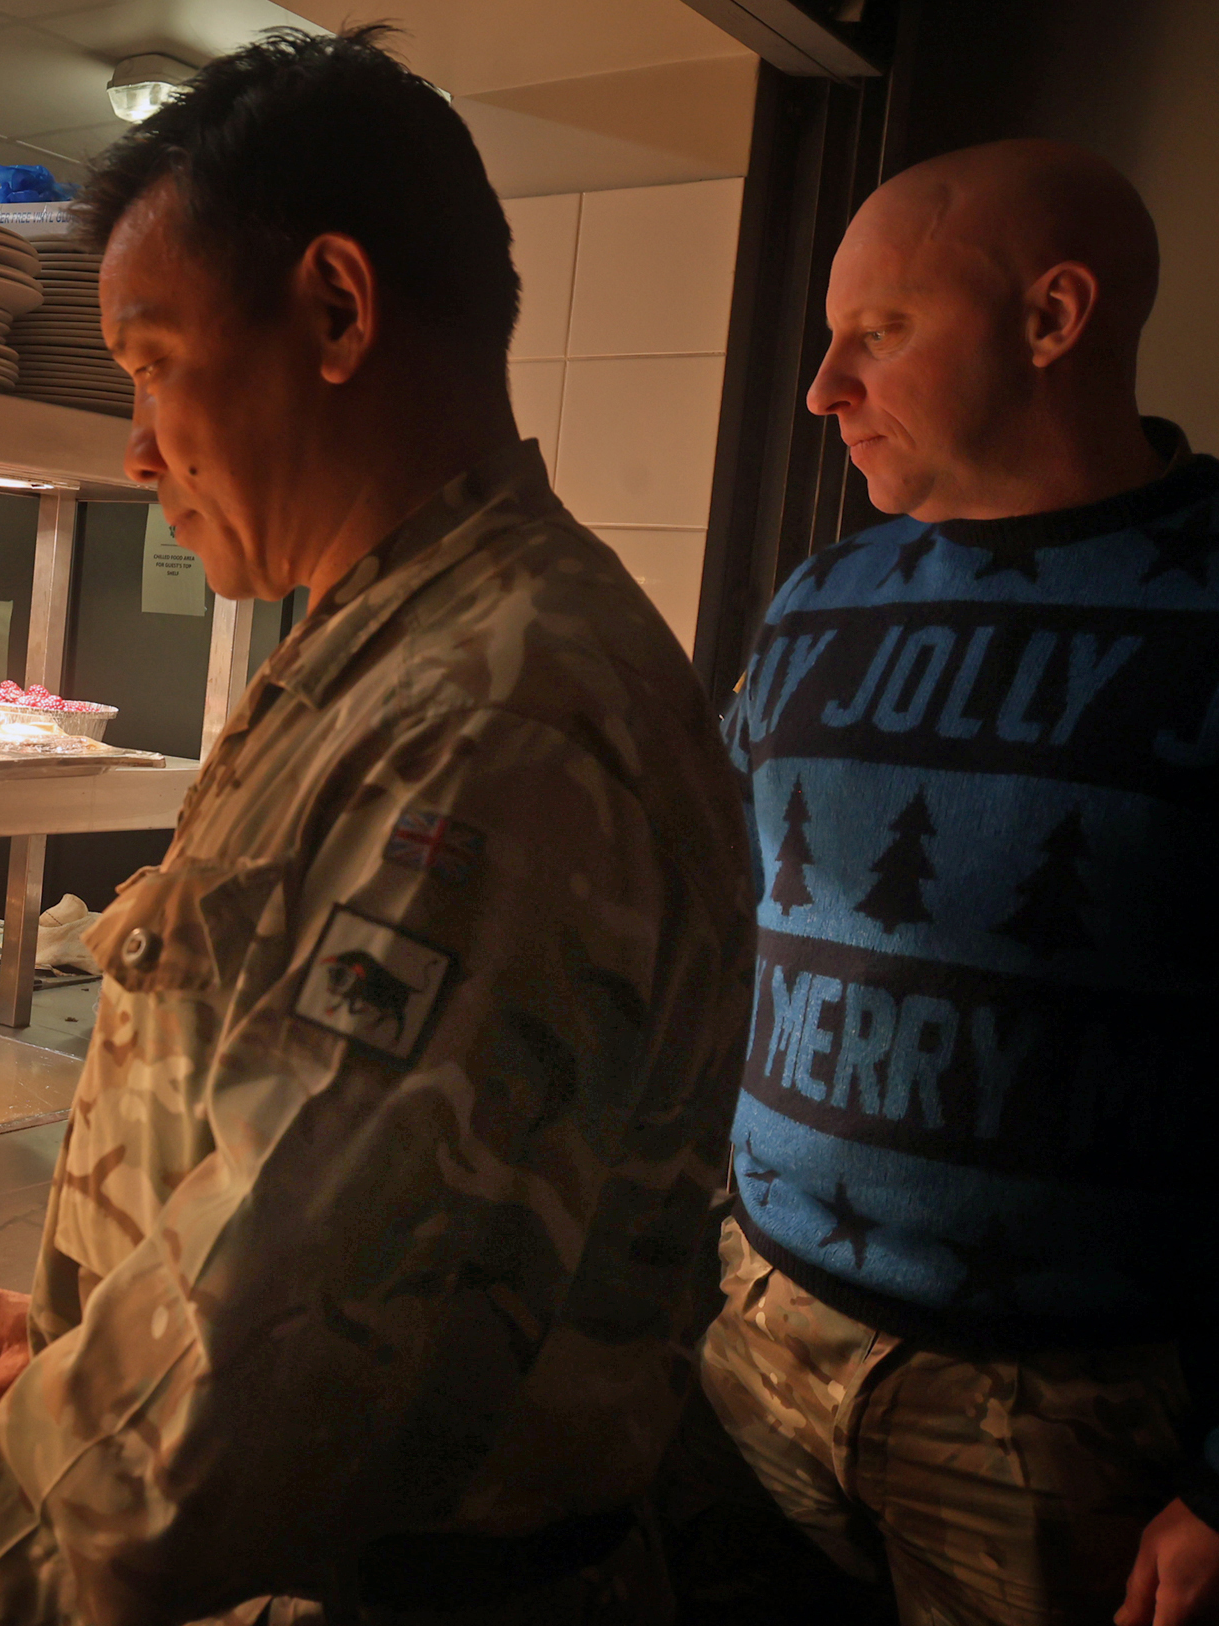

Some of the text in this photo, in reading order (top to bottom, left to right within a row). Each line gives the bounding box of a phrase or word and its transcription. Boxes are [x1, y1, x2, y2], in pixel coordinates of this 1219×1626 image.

[11, 211, 32, 224] FREE
[33, 211, 54, 223] VINYL
[821, 624, 1144, 746] JOLLY
[765, 964, 1041, 1138] MERRY
